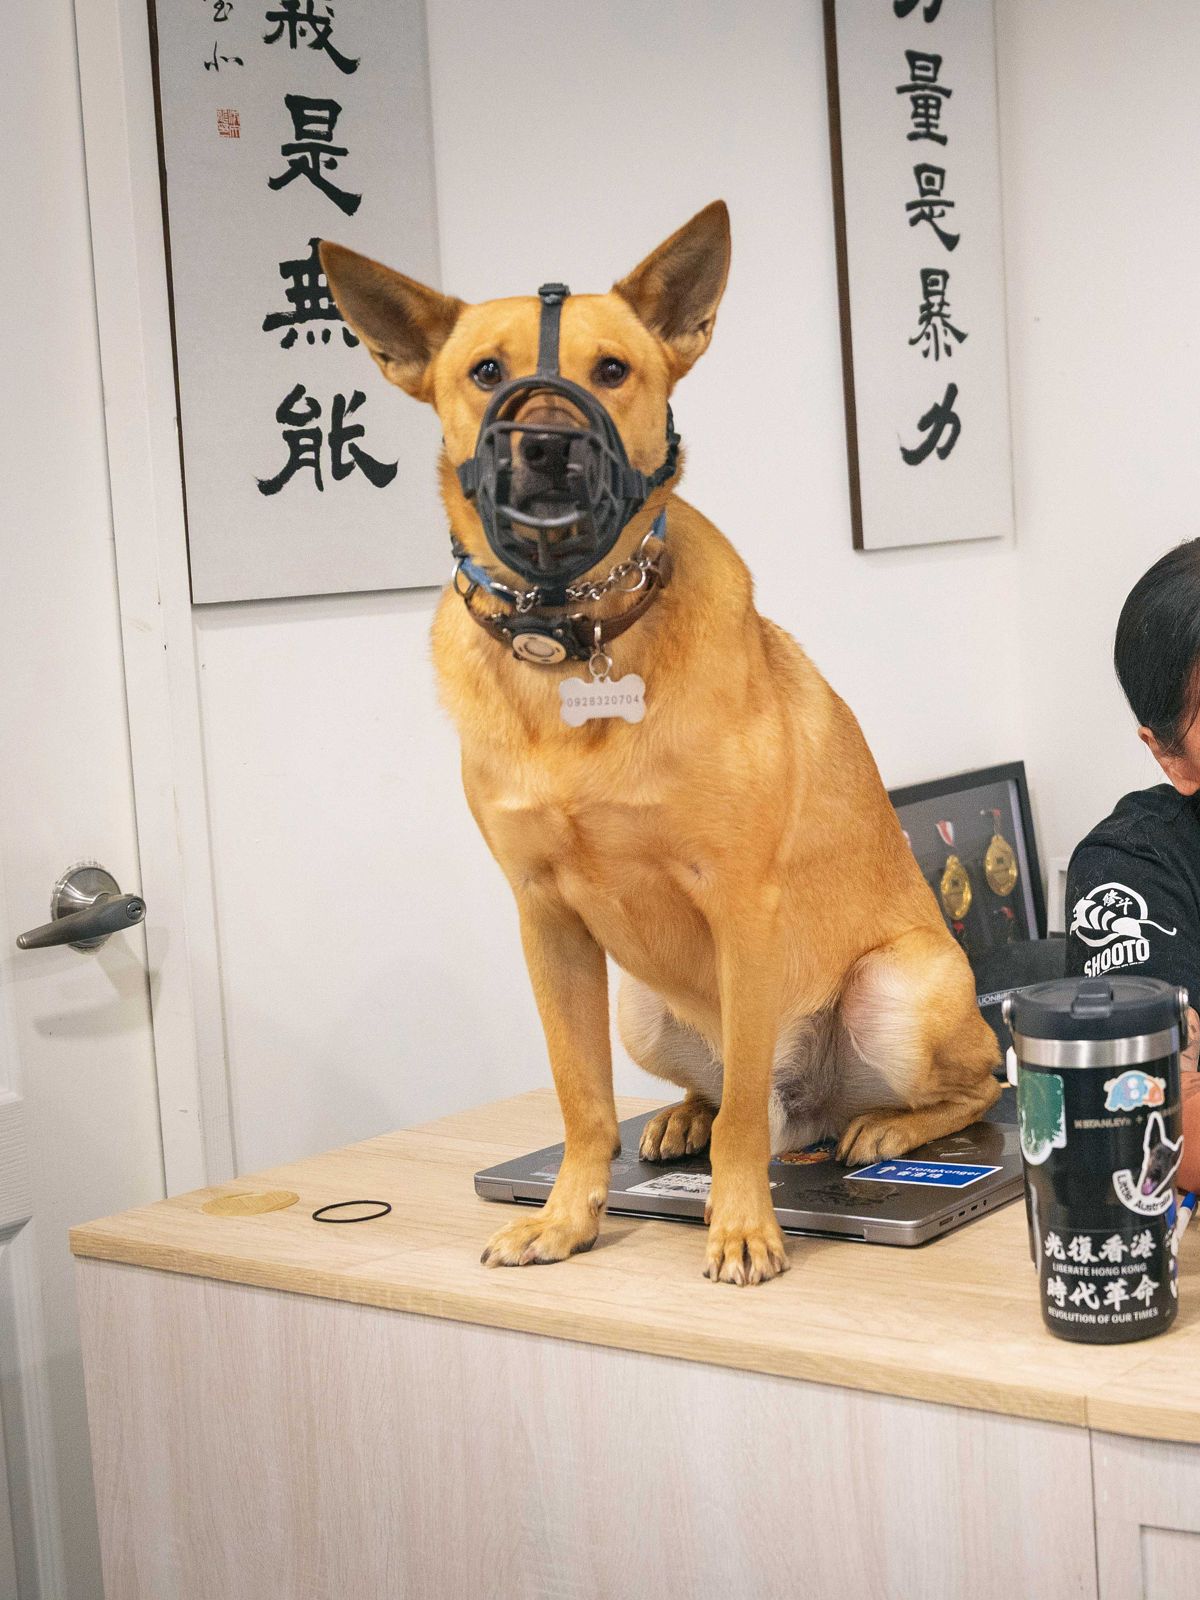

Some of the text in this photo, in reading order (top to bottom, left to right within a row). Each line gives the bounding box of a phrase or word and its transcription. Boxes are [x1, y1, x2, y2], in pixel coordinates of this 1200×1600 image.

[893, 0, 969, 466] 量是暴力
[1102, 889, 1133, 915] 修斗
[1084, 939, 1150, 978] SHOOTO
[905, 1166, 981, 1176] Hongkonger
[1117, 1174, 1133, 1201] Little
[1044, 1228, 1157, 1264] 光復香港
[1052, 1262, 1148, 1277] LIBERATE HONG KONG
[1046, 1274, 1160, 1312] 時代革命
[1047, 1305, 1159, 1325] REVOLUTION OF OUR TIMES
